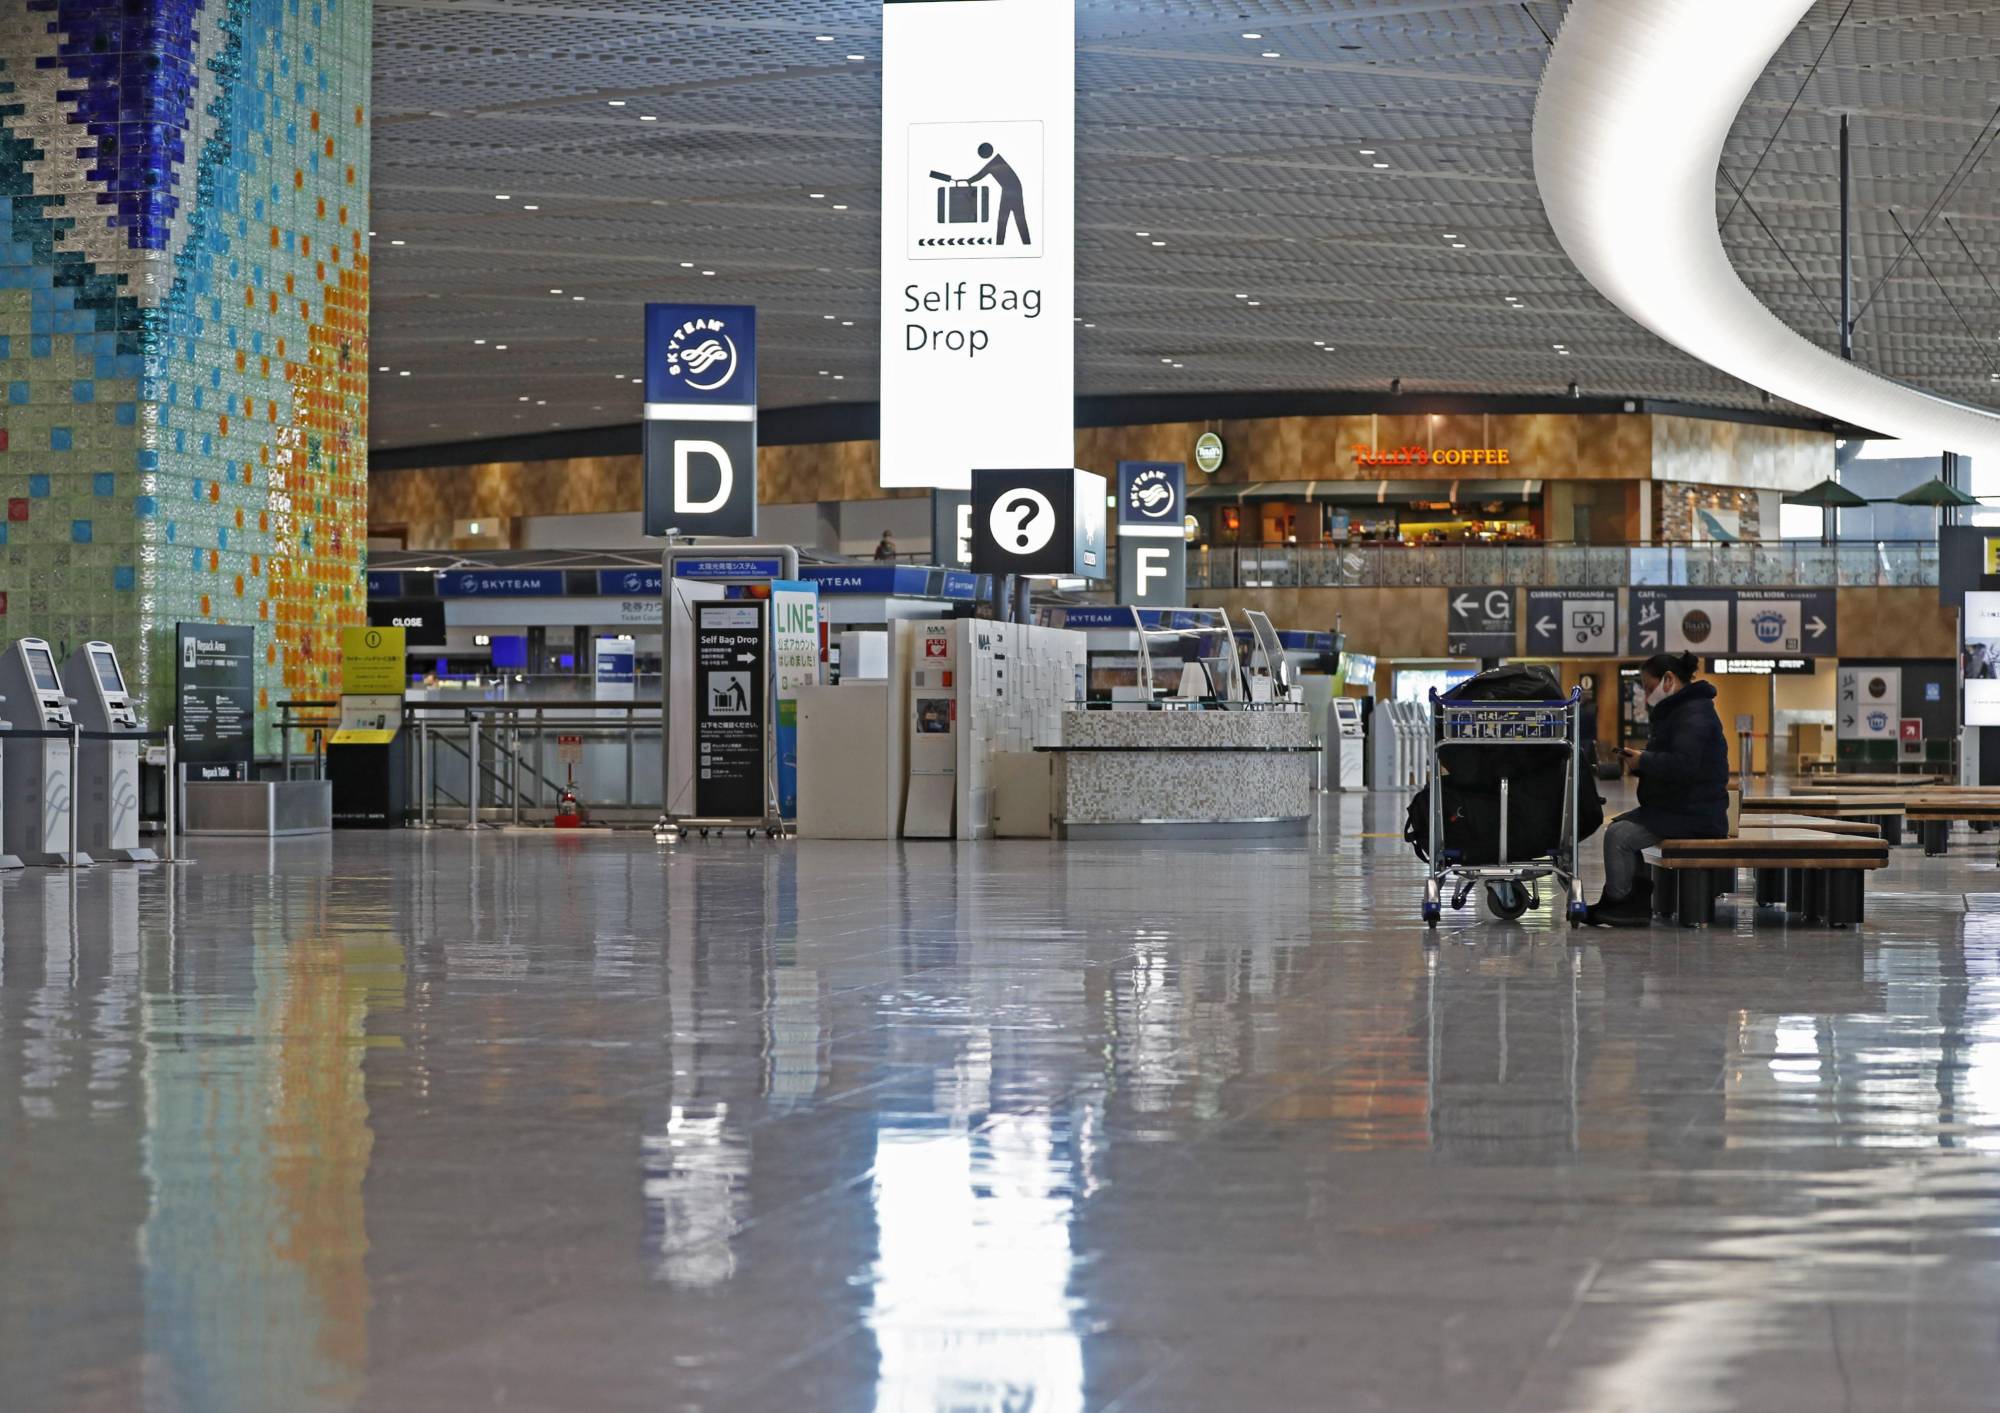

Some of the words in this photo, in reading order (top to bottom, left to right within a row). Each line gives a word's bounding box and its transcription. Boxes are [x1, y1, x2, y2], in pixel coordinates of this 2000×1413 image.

[904, 281, 967, 312] Self
[979, 283, 1042, 319] Bag
[667, 318, 724, 376] SKYTEAM
[906, 324, 989, 358] Drop
[1432, 448, 1509, 465] COFFEE
[673, 439, 734, 514] D
[1130, 470, 1167, 508] SKYTEAM
[1137, 547, 1170, 596] F
[482, 580, 541, 589] SKYTEAM
[1530, 591, 1567, 599] CURRENCY
[1568, 591, 1605, 599] EXCHANGE
[1737, 590, 1763, 599] TRAVEL
[1764, 591, 1786, 599] KIOSK
[1485, 589, 1510, 619] G
[392, 617, 423, 628] CLOSE
[777, 603, 815, 634] LINE
[700, 635, 718, 644] Self
[719, 635, 735, 646] Bag
[736, 635, 758, 646] Drop
[778, 639, 816, 651] 公式アカウント
[1459, 643, 1467, 654] F
